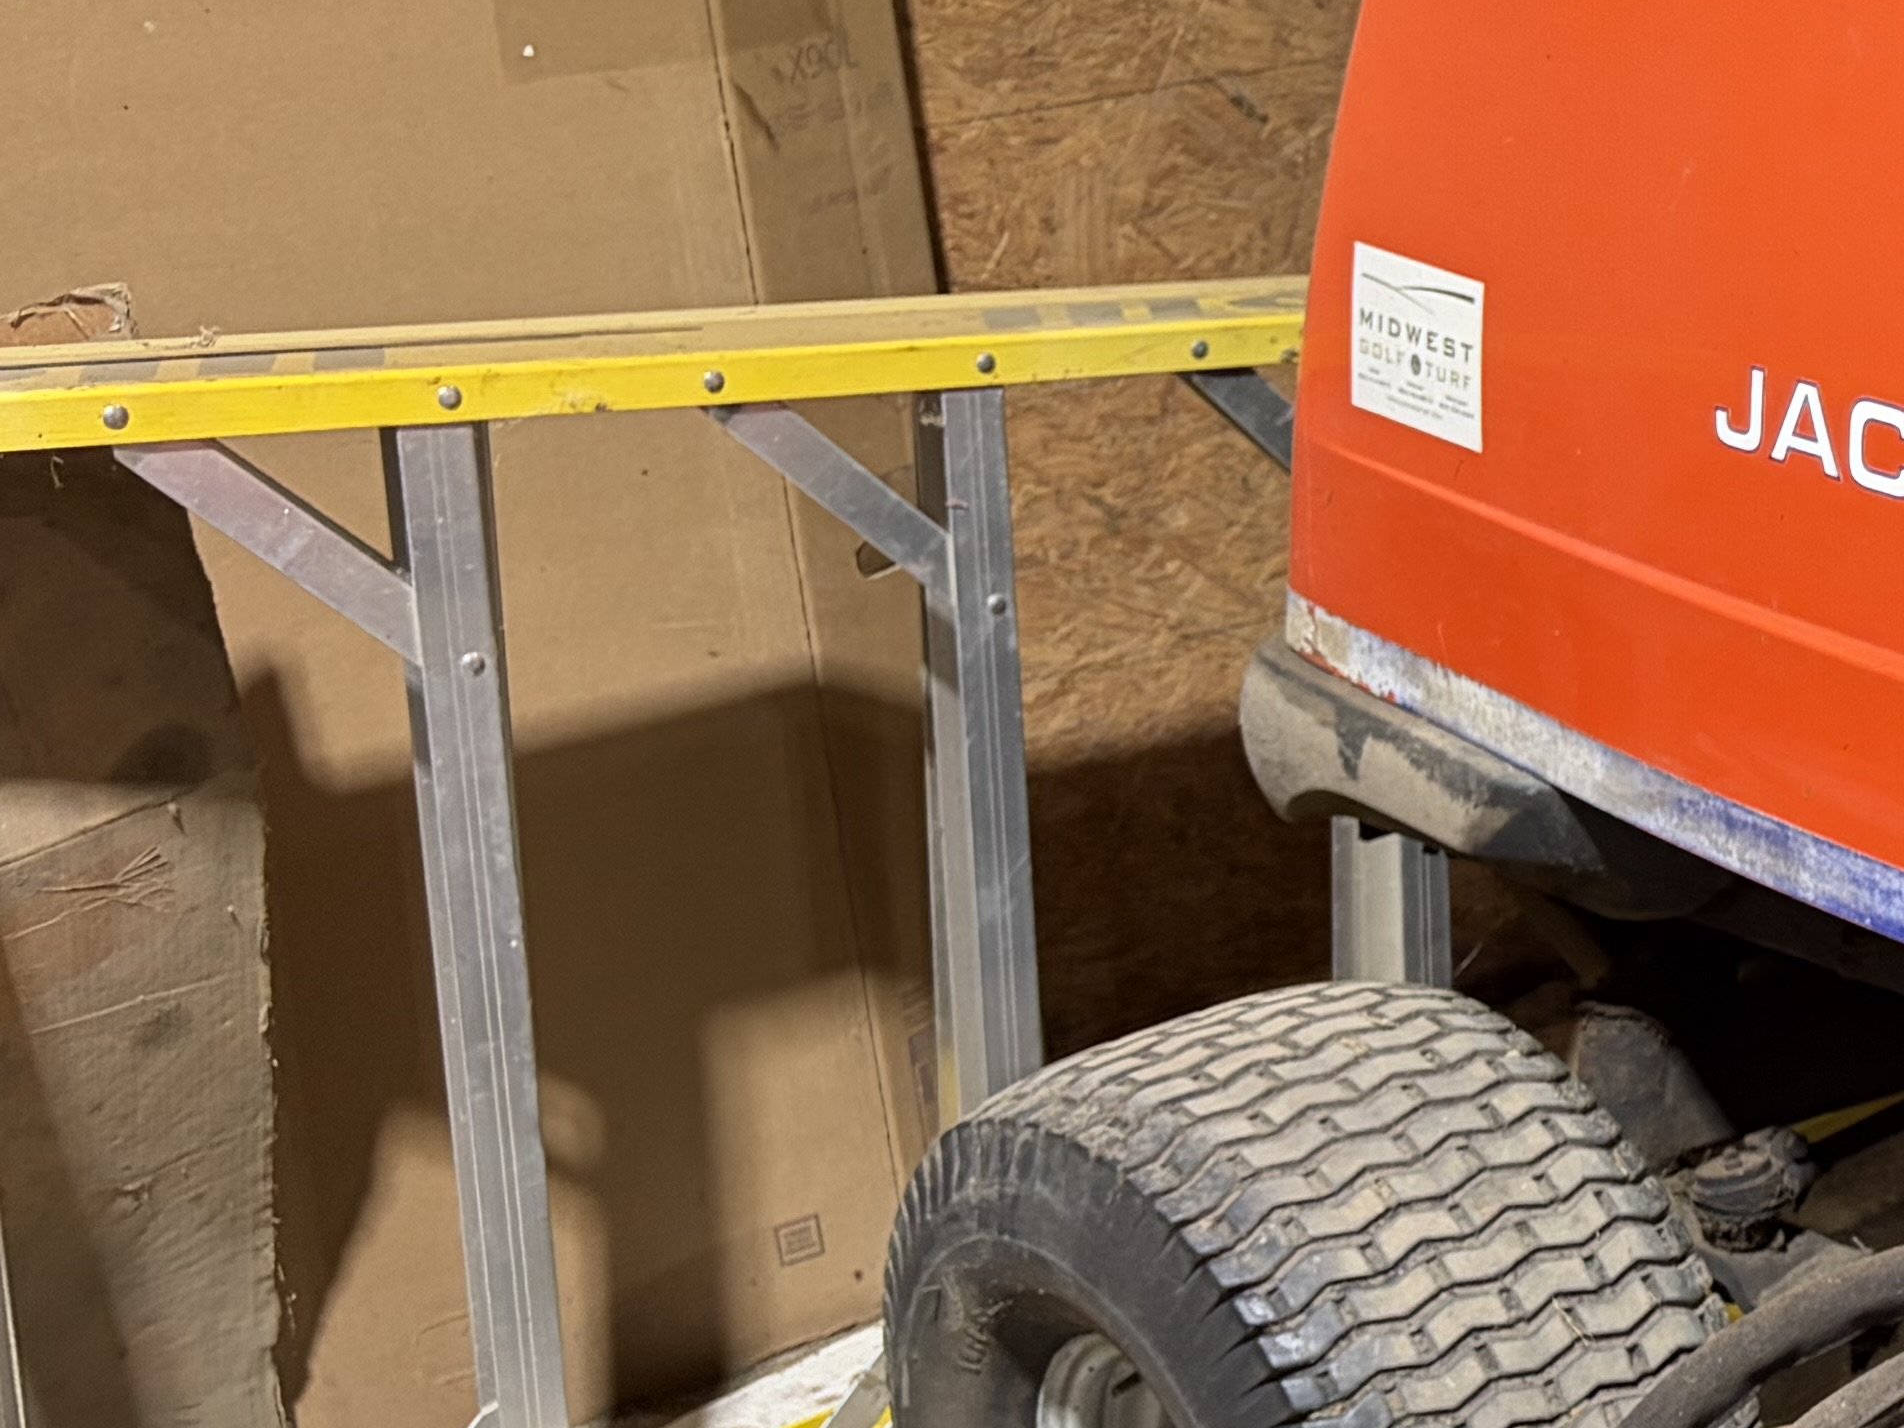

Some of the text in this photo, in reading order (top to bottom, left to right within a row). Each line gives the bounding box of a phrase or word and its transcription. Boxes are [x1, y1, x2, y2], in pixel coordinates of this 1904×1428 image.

[1360, 307, 1474, 363] MIDWEST
[1360, 338, 1472, 390] GOLF TURF
